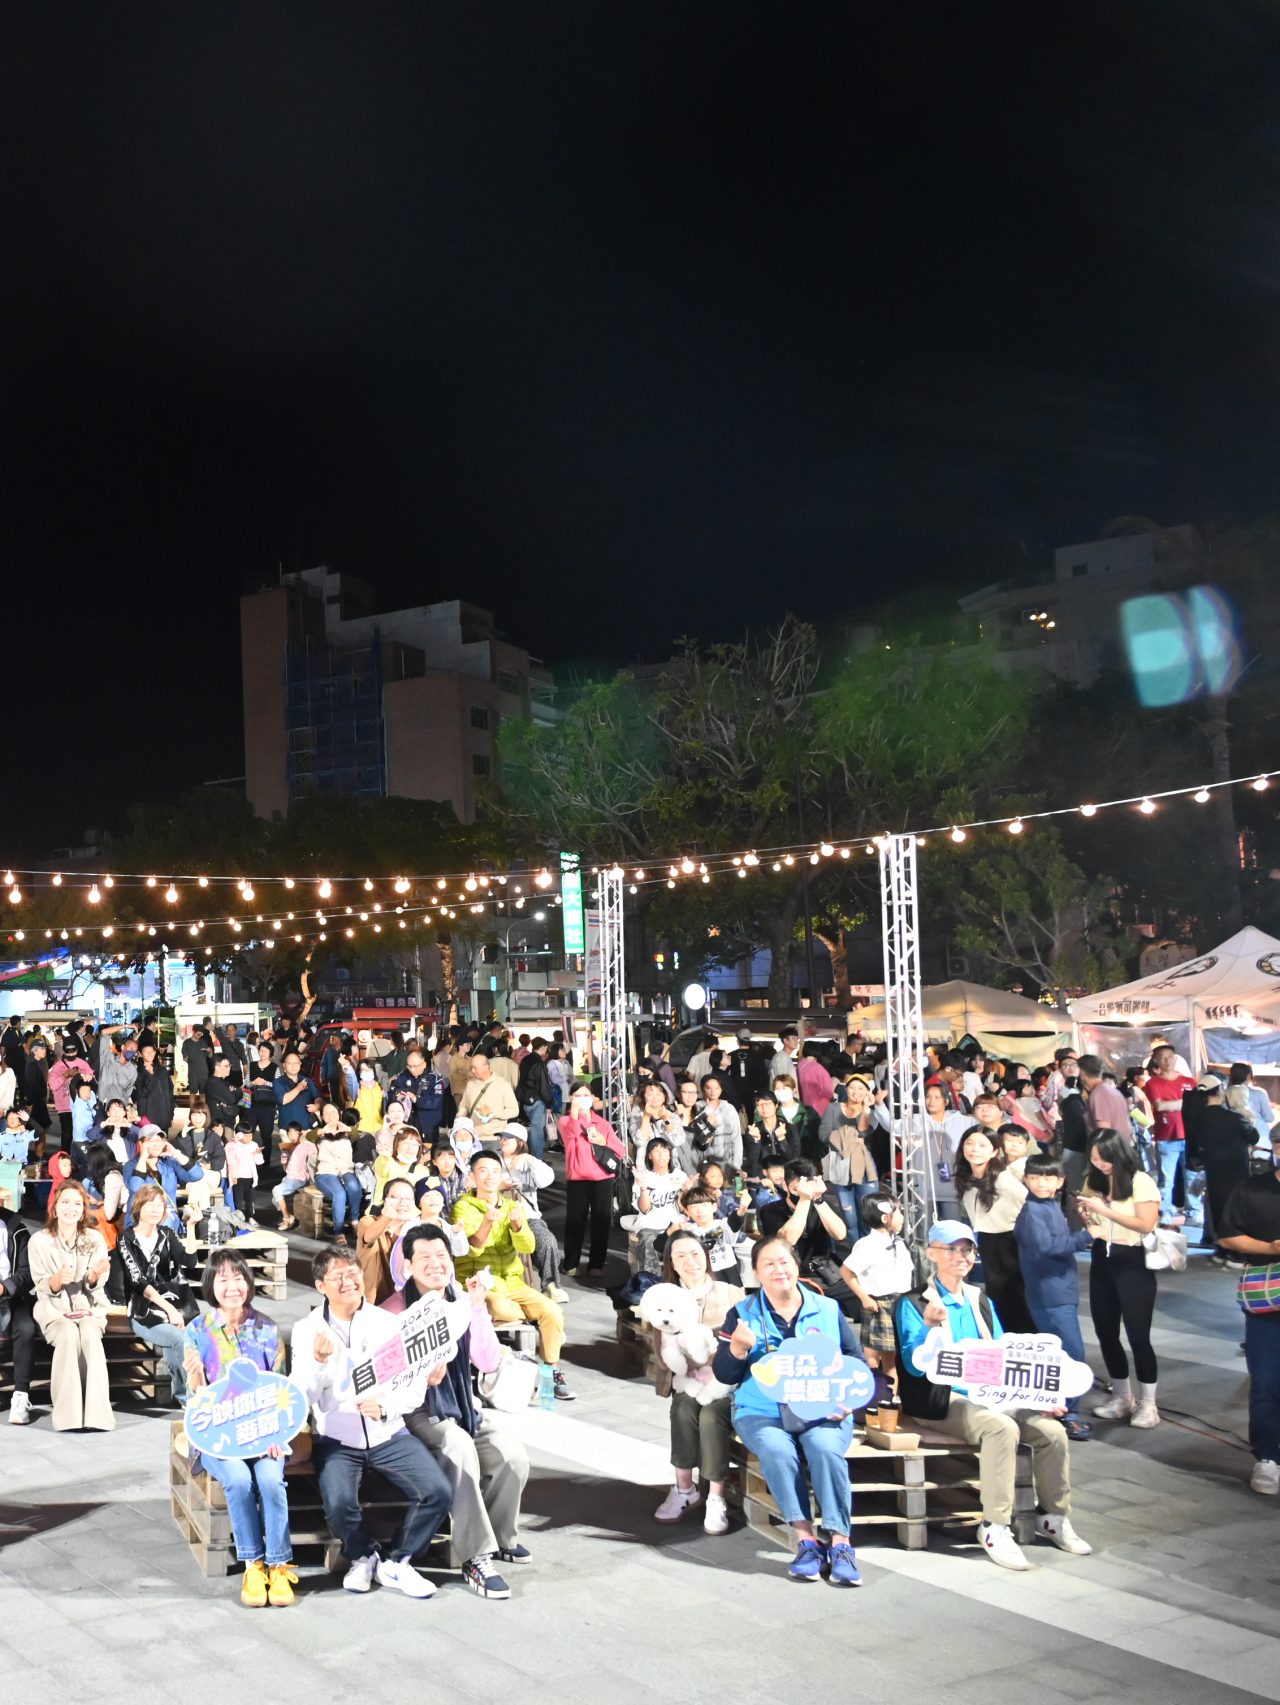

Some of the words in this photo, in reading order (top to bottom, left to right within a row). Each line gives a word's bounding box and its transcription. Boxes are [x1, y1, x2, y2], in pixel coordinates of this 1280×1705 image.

[402, 1299, 436, 1330] 2025
[1006, 1341, 1053, 1352] 2025
[392, 1374, 414, 1391] Sing
[433, 1346, 452, 1364] love
[772, 1355, 818, 1376] 耳朵
[977, 1385, 1007, 1404] Sing
[1009, 1388, 1031, 1402] for
[1033, 1391, 1058, 1404] love
